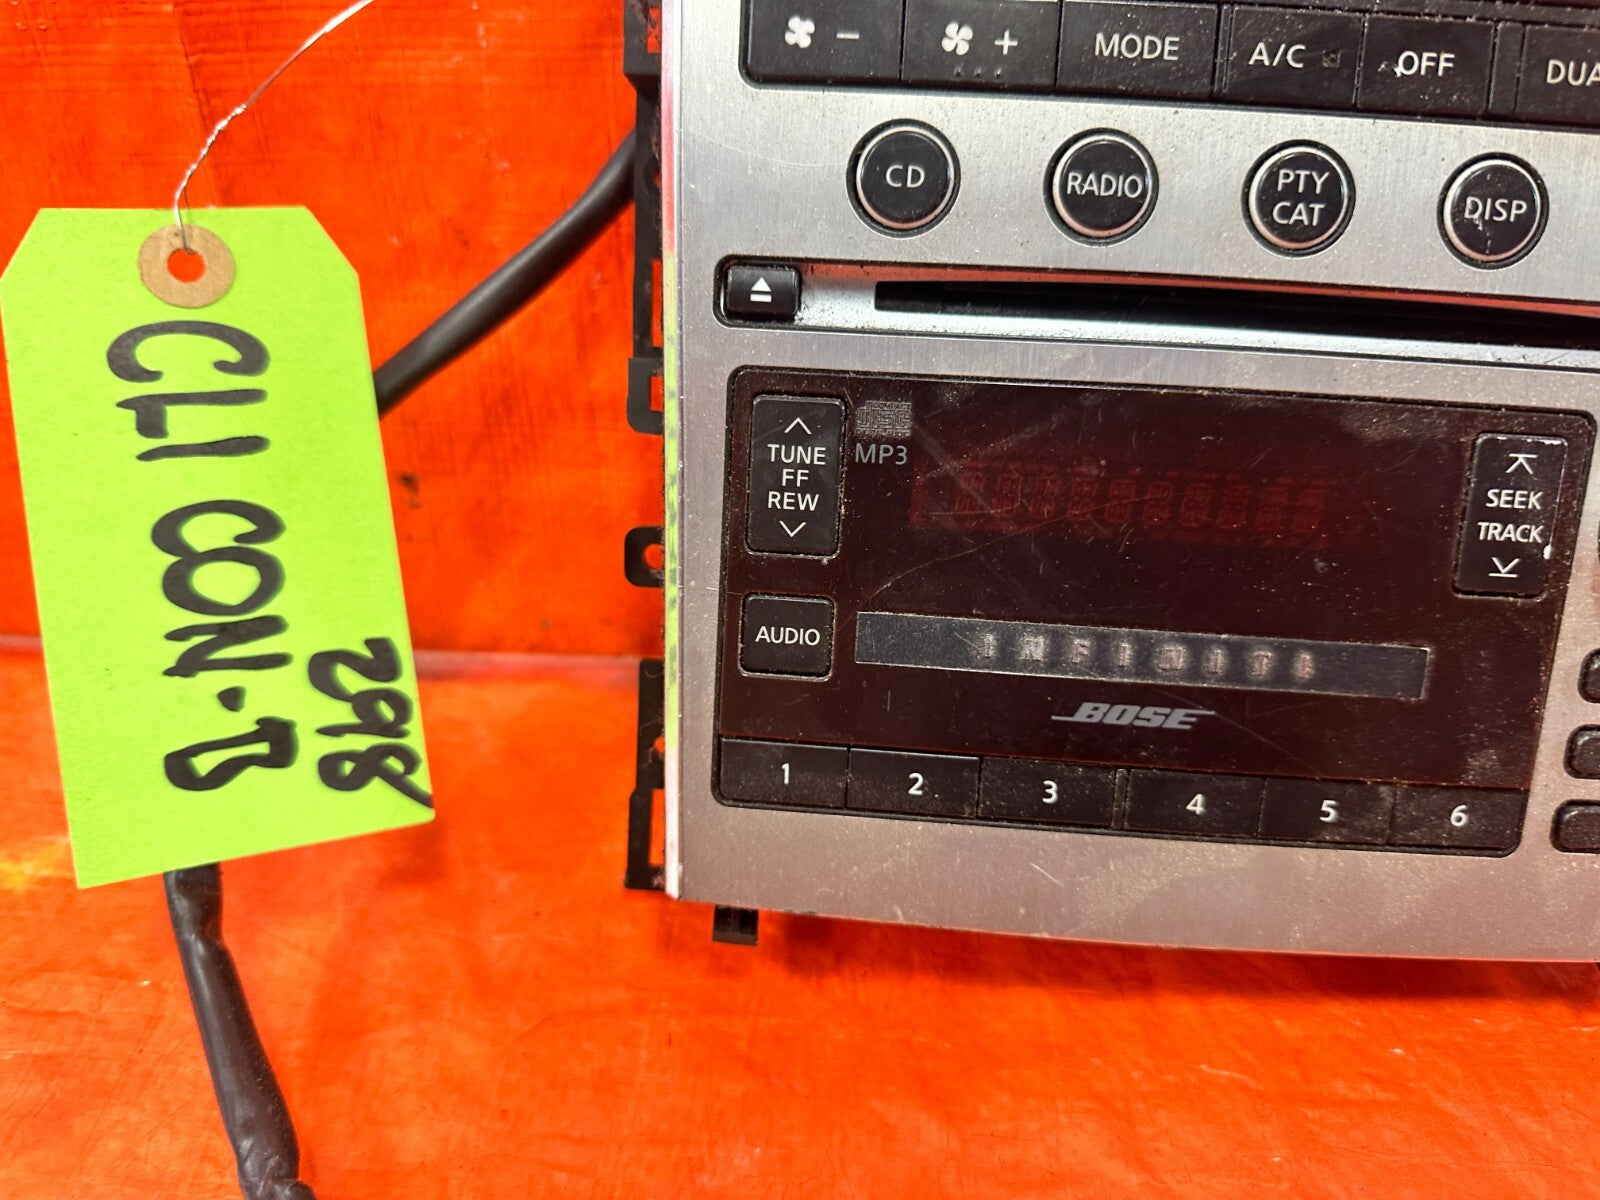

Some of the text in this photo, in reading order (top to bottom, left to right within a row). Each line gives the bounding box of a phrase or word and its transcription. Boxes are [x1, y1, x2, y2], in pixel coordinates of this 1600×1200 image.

[1094, 32, 1180, 61] MODE
[1248, 42, 1306, 69] A/C
[1397, 51, 1455, 77] OFF
[885, 164, 926, 188] CD
[1066, 172, 1143, 198] RADIO
[1277, 169, 1329, 194] PTY
[1272, 202, 1325, 226] CAT
[1463, 197, 1527, 226] DISP
[767, 444, 827, 465] TUNE
[855, 443, 908, 465] MP3
[781, 469, 810, 487] FF
[767, 491, 820, 511] REW
[1485, 489, 1543, 510] SEEK
[1477, 522, 1544, 544] TRACK
[755, 625, 821, 646] AUDIO
[1051, 702, 1216, 730] BOSE
[781, 762, 790, 784] 1
[908, 773, 923, 796] 2
[1042, 781, 1057, 804] 3
[1186, 794, 1205, 815] 4
[1320, 800, 1337, 823] 5
[1450, 805, 1468, 827] 6
